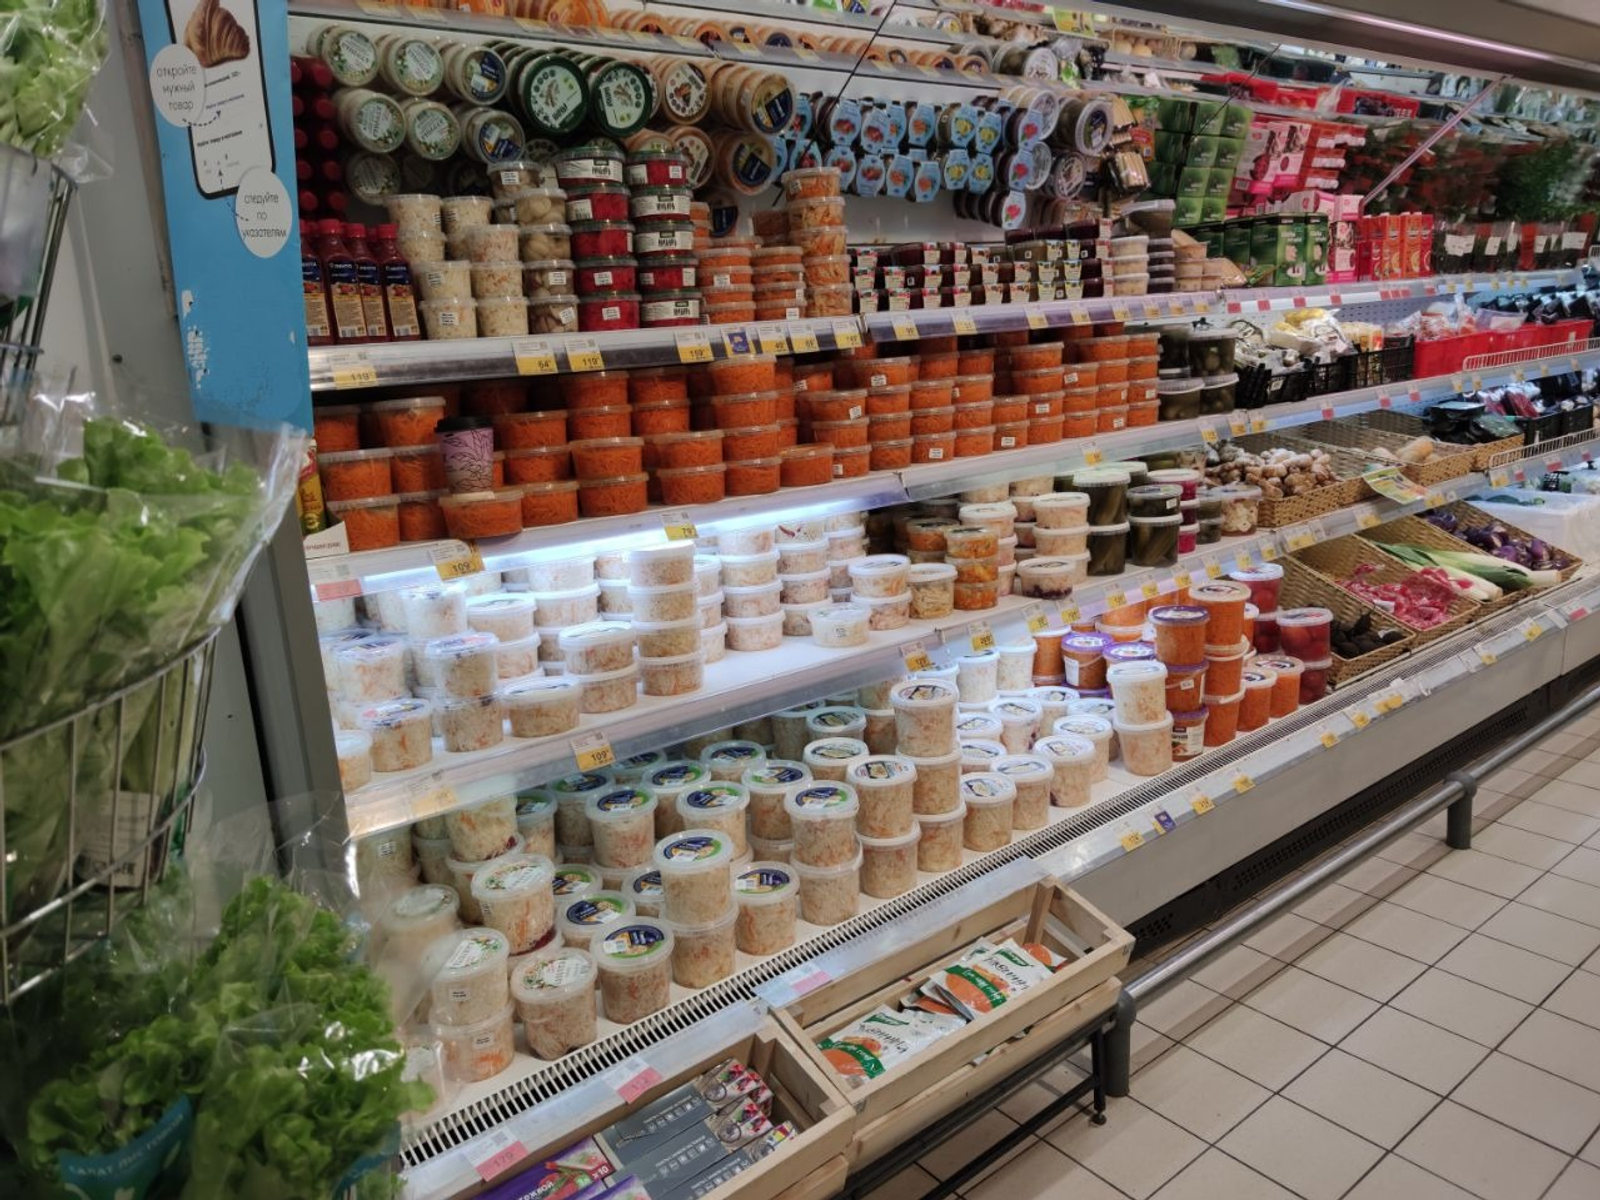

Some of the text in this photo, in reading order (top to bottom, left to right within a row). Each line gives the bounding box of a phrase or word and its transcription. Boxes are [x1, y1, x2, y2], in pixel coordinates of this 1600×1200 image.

[156, 62, 197, 79] откройте
[162, 80, 195, 97] нужный
[168, 101, 193, 111] товар
[244, 191, 279, 204] следуйте
[256, 211, 268, 221] по
[241, 228, 287, 241] указателям
